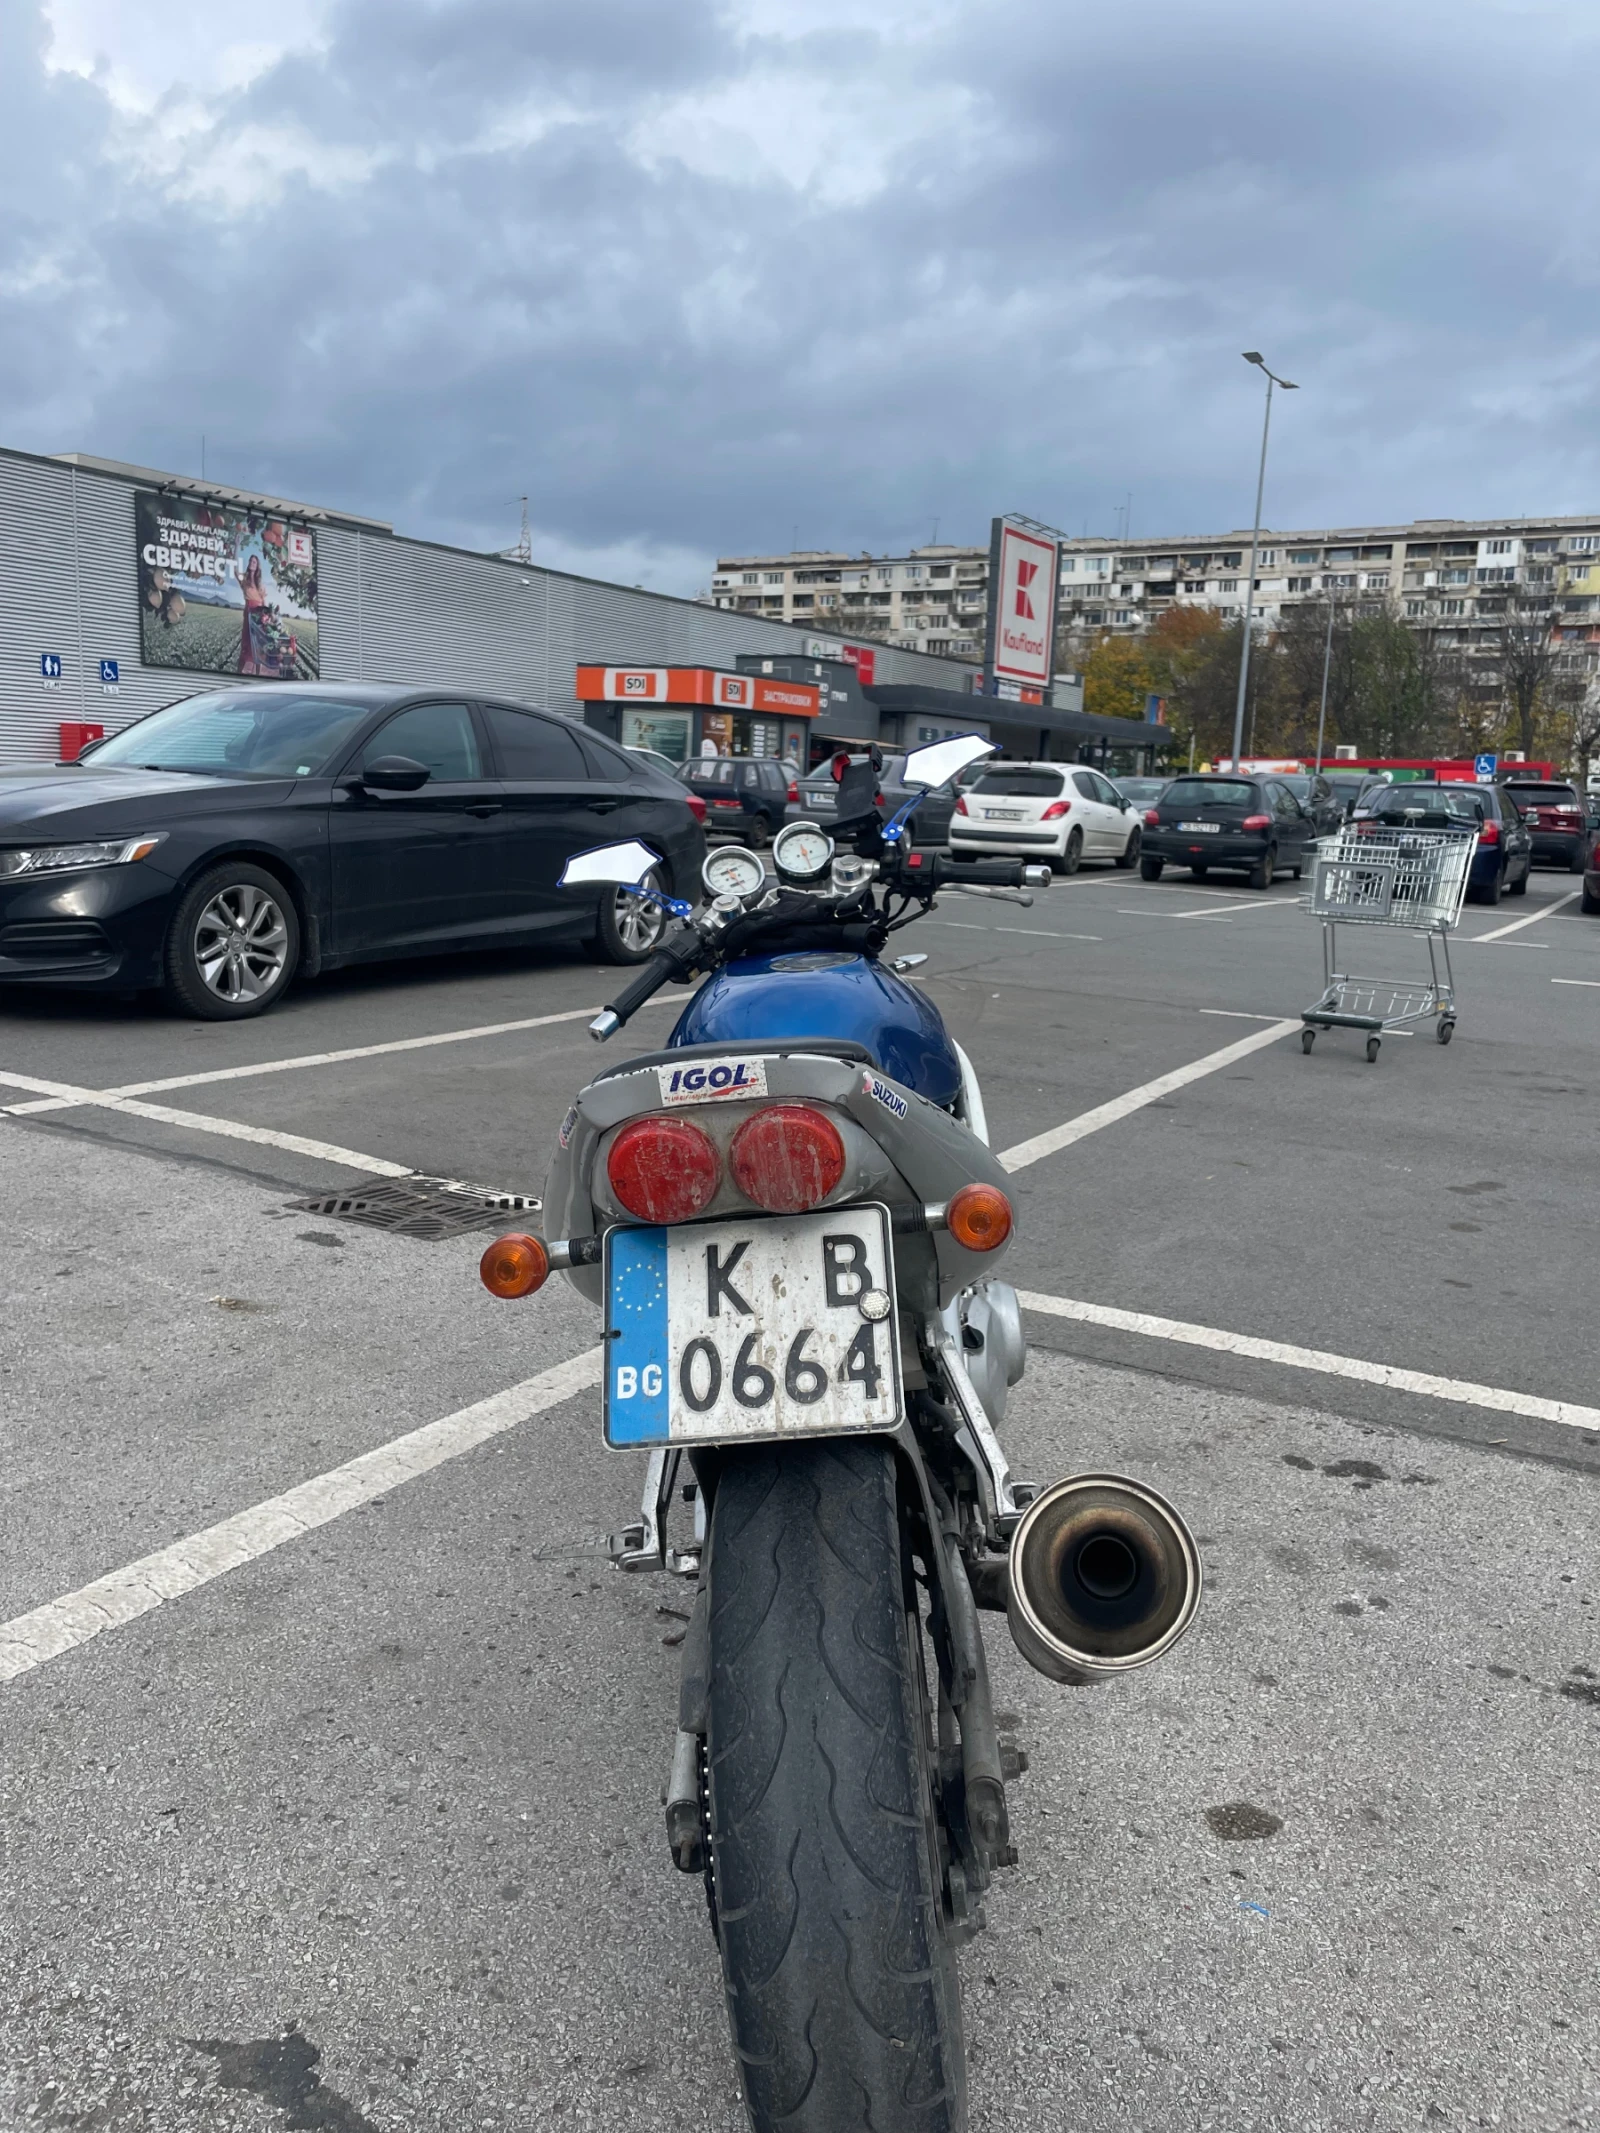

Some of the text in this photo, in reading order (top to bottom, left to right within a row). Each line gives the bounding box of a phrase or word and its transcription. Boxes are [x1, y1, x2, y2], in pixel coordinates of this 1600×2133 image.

[160, 528, 227, 555] ЗДРАВЕЙ,
[143, 543, 244, 581] СВЕЖЕСТ!
[1003, 628, 1043, 656] Kaufland
[626, 677, 646, 689] SDI
[727, 683, 741, 696] SDI
[872, 1080, 907, 1118] SUZUKI
[706, 1234, 873, 1317] K B
[617, 1364, 663, 1400] BG
[680, 1323, 881, 1412] 0664
